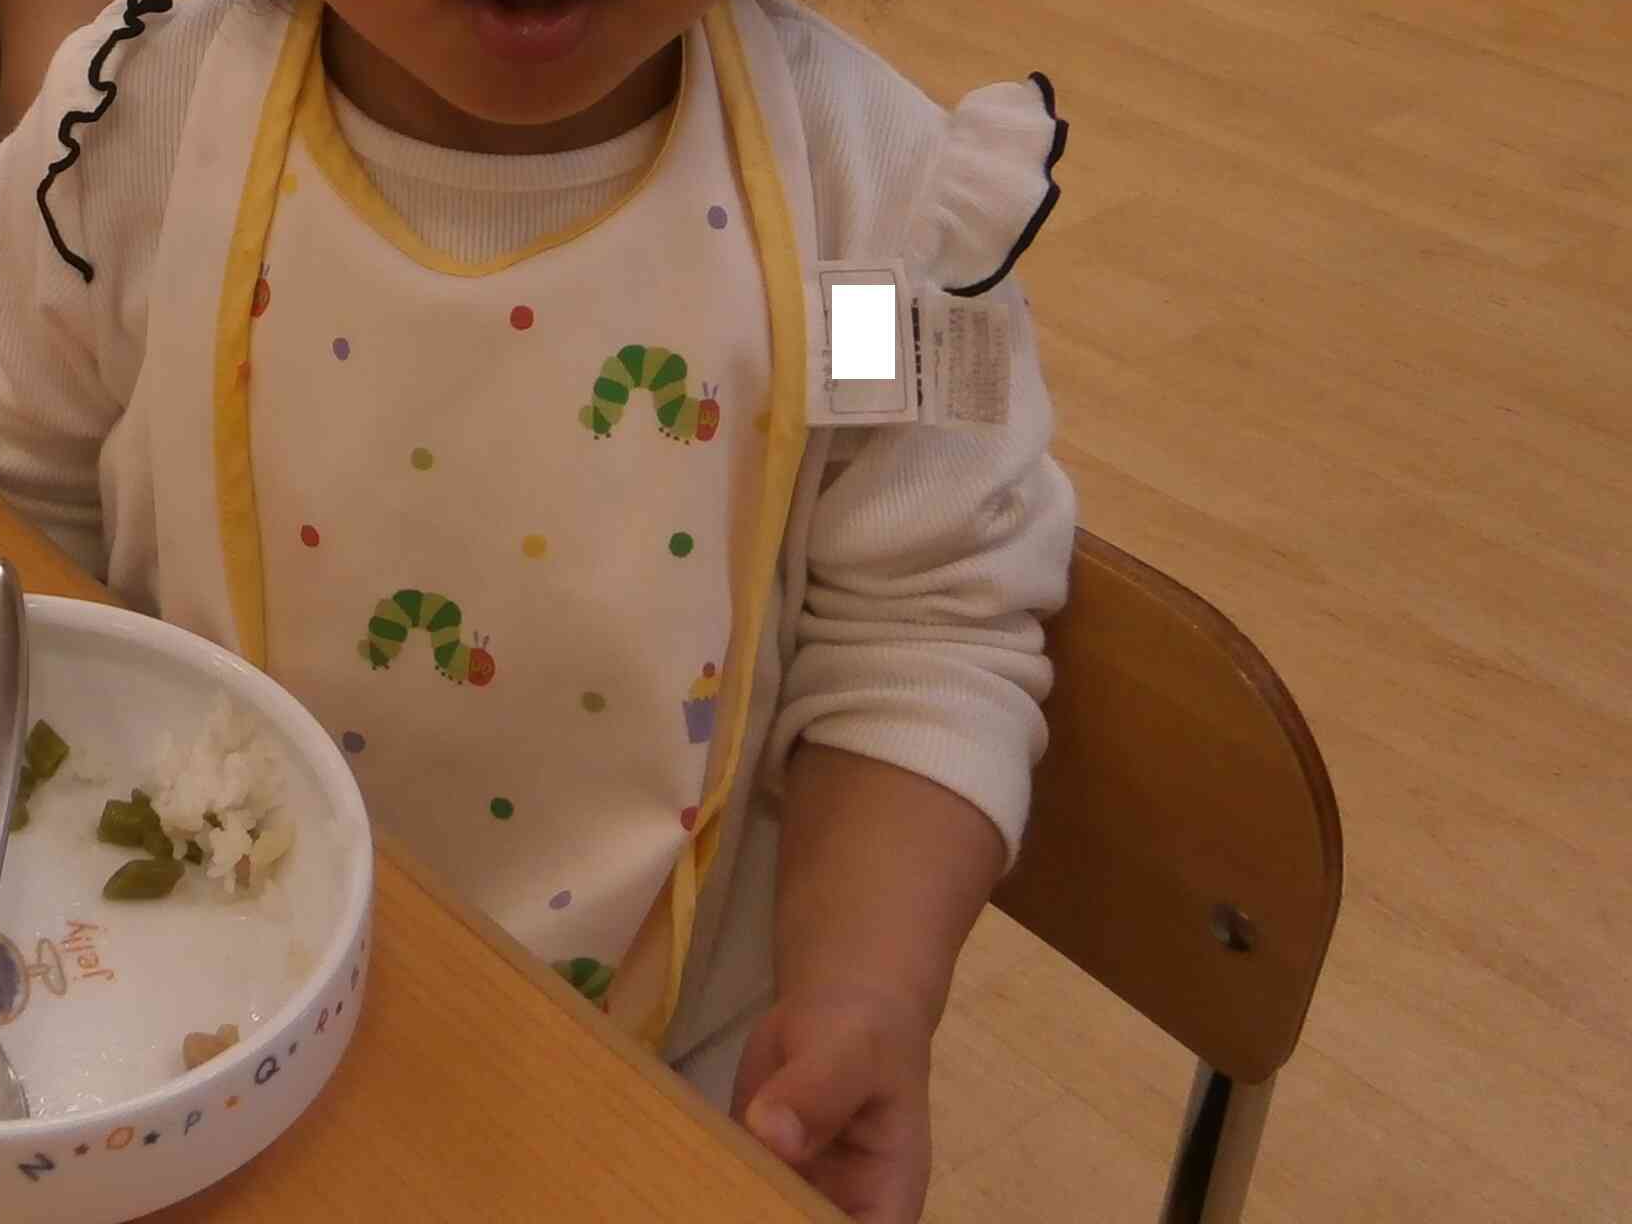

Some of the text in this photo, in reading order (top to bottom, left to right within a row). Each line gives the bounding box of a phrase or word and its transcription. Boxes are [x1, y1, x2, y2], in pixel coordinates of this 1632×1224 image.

[105, 1126, 135, 1150] O
[183, 1109, 202, 1136] P
[254, 1056, 280, 1085] Q
